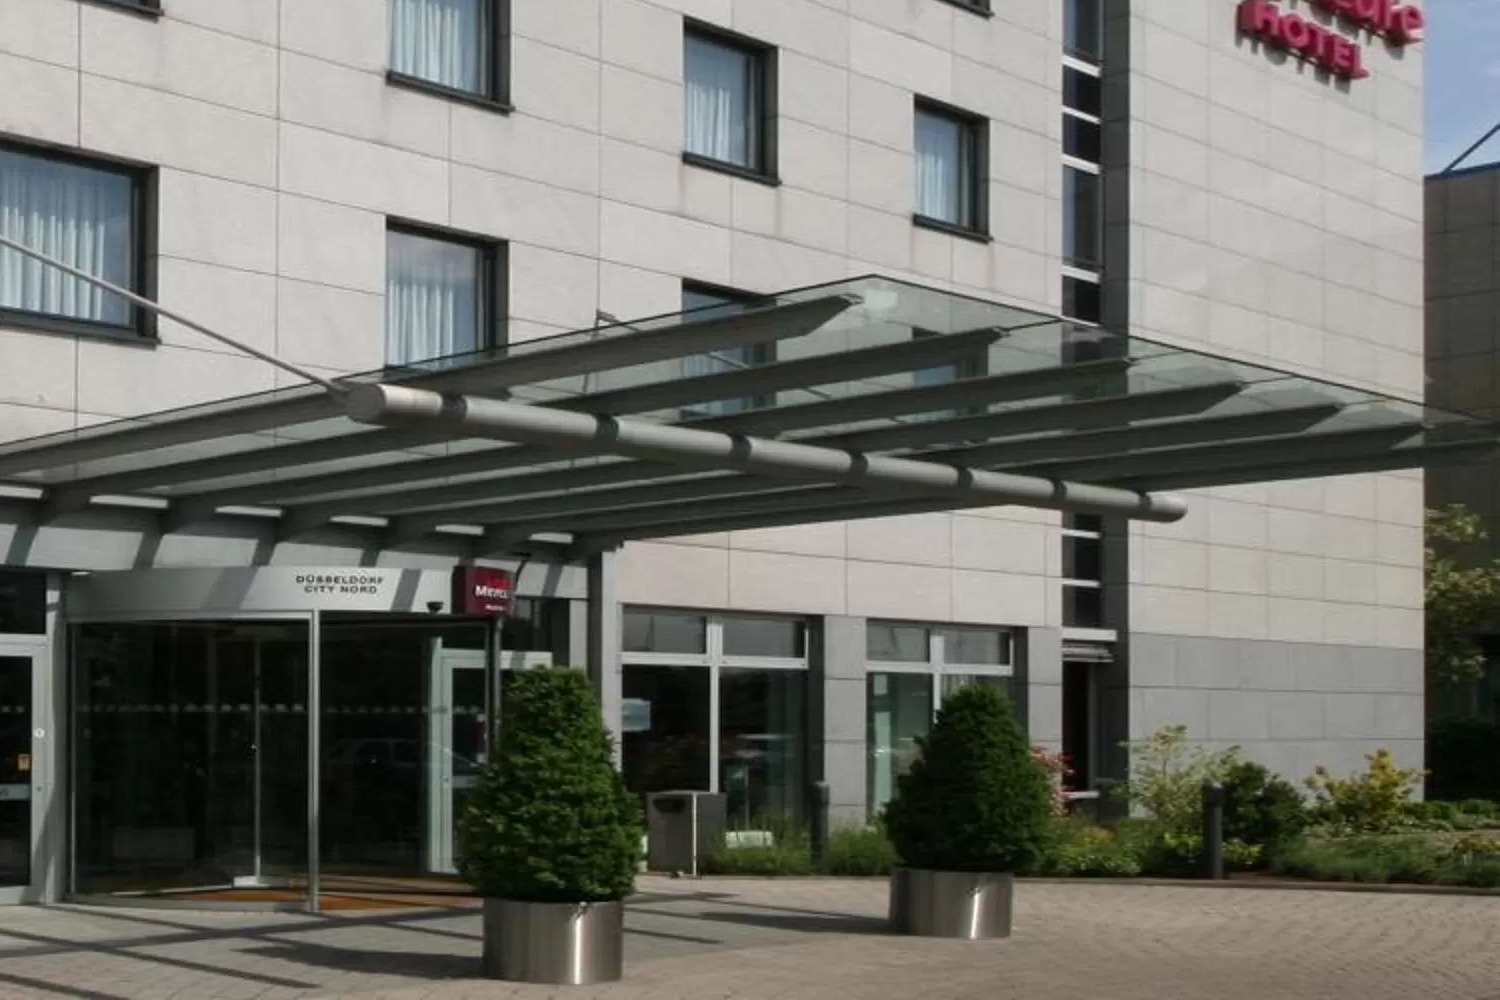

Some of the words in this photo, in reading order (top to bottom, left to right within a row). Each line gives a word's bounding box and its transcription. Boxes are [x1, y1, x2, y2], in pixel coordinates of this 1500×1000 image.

[295, 574, 384, 584] DÜSSELDORF
[304, 585, 334, 594] CITY
[340, 585, 377, 594] NORD
